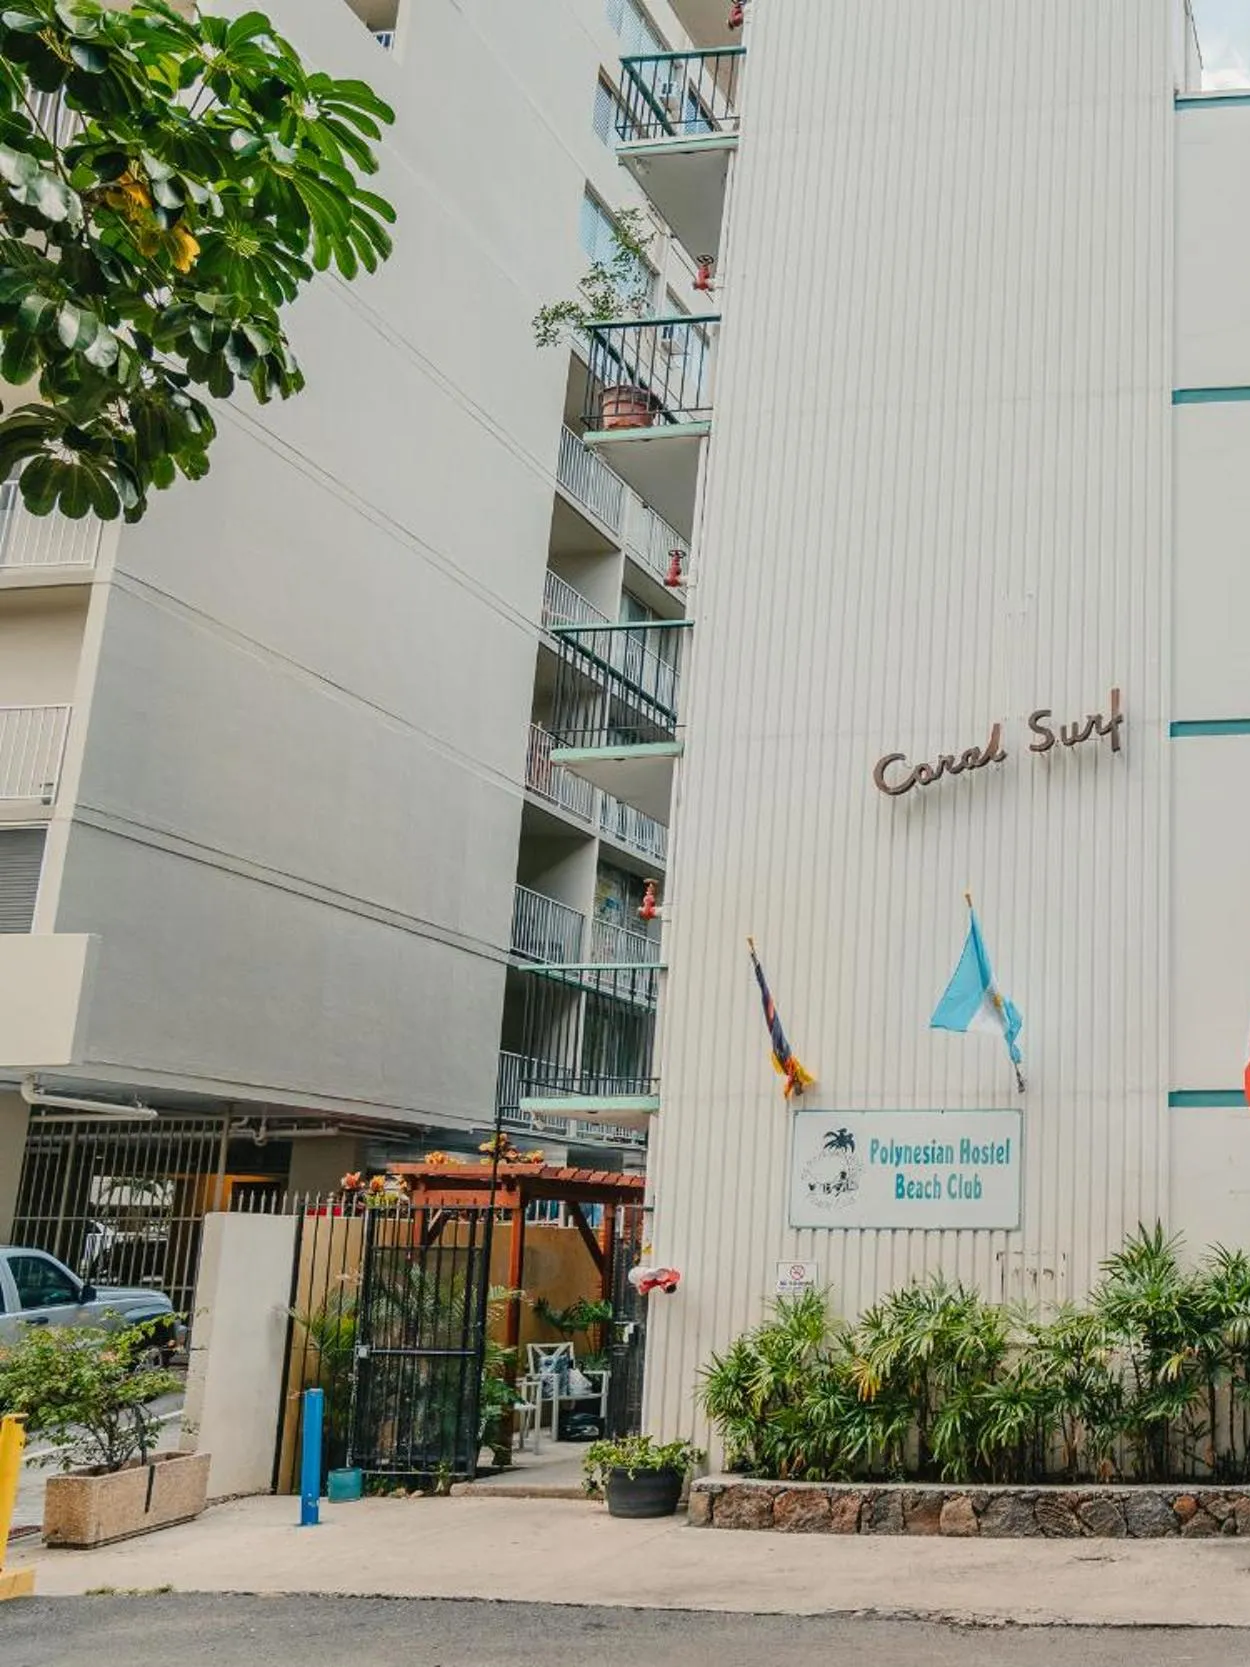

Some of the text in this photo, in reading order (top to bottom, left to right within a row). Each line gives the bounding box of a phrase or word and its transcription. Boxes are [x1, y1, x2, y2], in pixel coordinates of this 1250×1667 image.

[872, 687, 1124, 796] Coral Surf
[869, 1137, 1011, 1168] Polynesian Hostel
[895, 1173, 983, 1201] Beach Club
